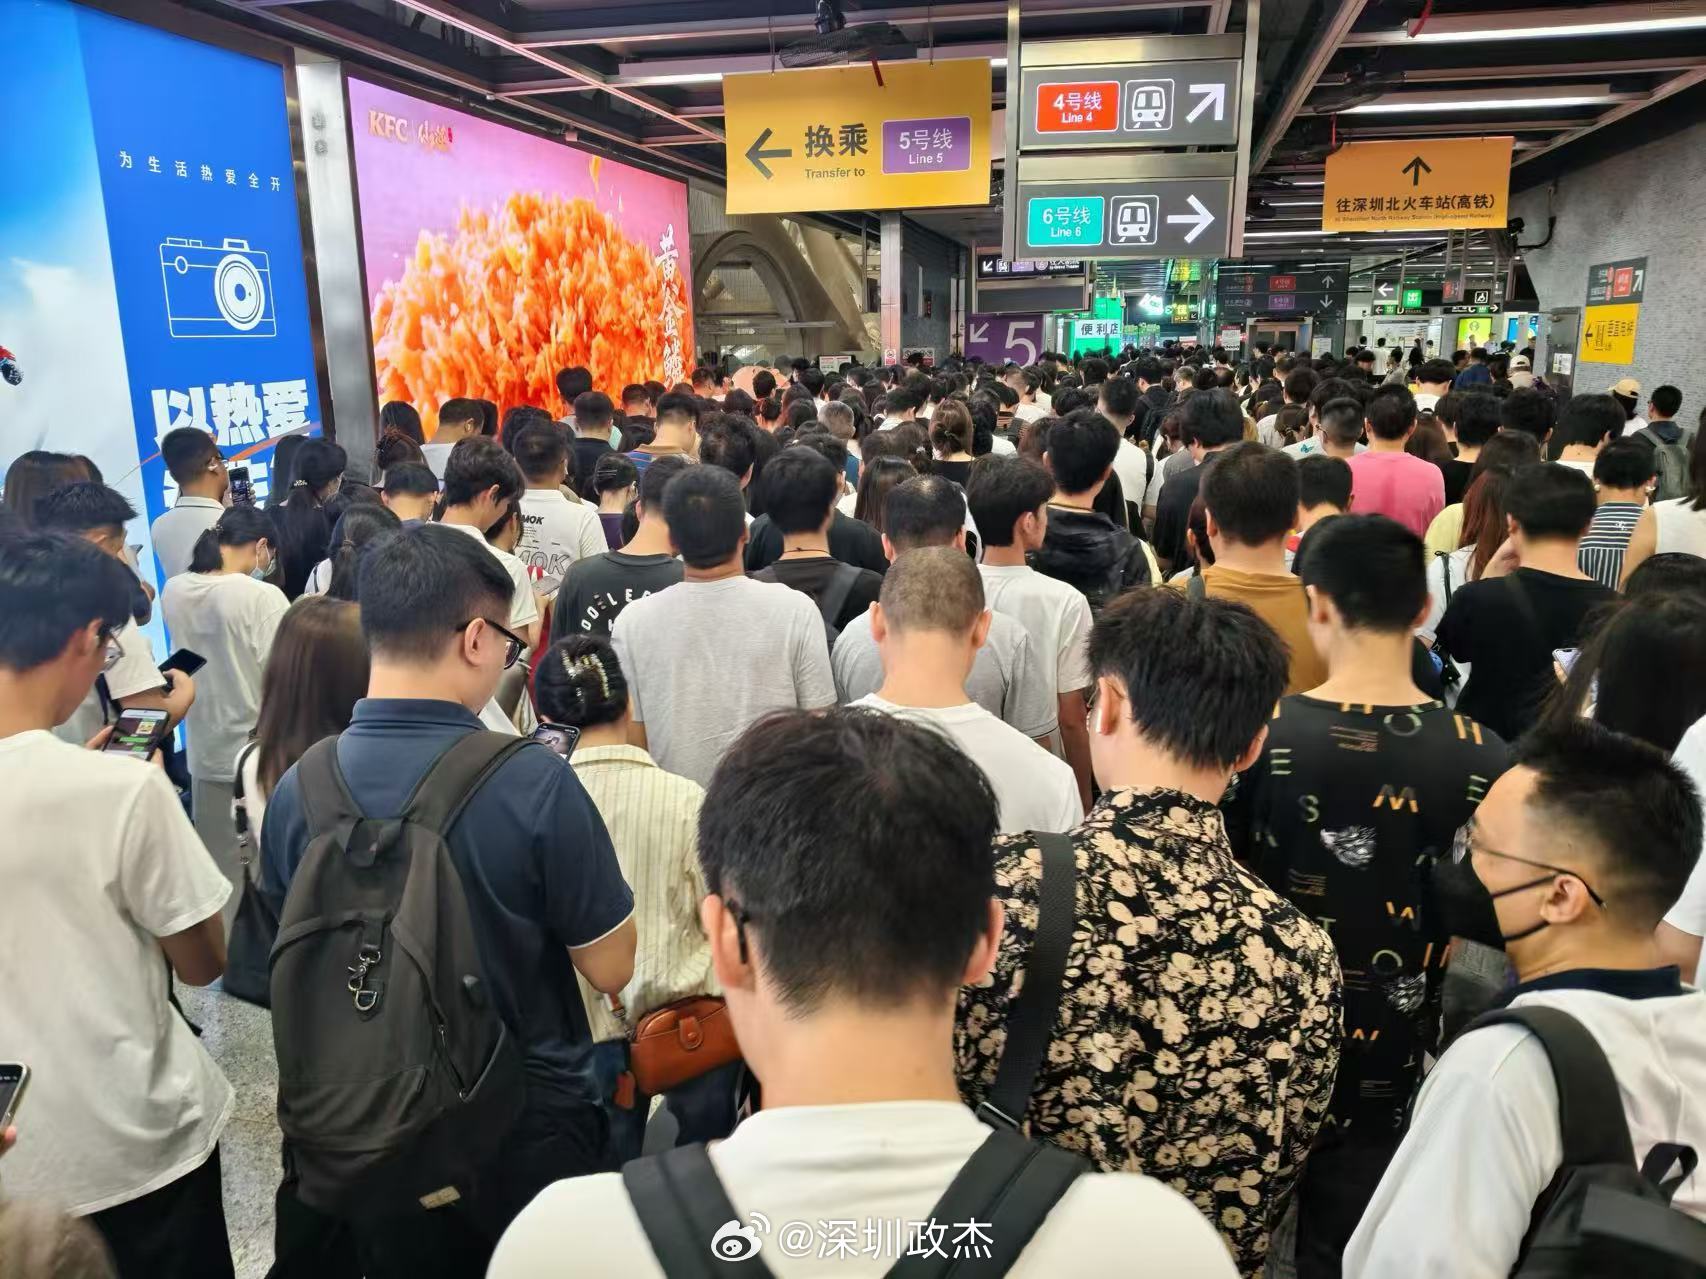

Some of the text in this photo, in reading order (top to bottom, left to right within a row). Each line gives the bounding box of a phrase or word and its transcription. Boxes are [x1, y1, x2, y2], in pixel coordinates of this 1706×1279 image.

[1053, 91, 1102, 111] 4号线
[368, 109, 408, 143] KFC
[1061, 112, 1093, 124] Line 4
[804, 122, 868, 158] 换乘
[899, 128, 953, 151] 5号线
[909, 153, 944, 165] Line 5
[119, 150, 281, 192] 为生活热爱全开
[804, 167, 866, 179] Transfer to
[1335, 194, 1496, 213] 往深圳北火车站(高铁)
[1042, 205, 1092, 225] 6号线
[1050, 226, 1082, 238] Line 6
[1081, 322, 1119, 336] 便利店
[1004, 321, 1037, 369] 5
[151, 379, 311, 450] 以热爱
